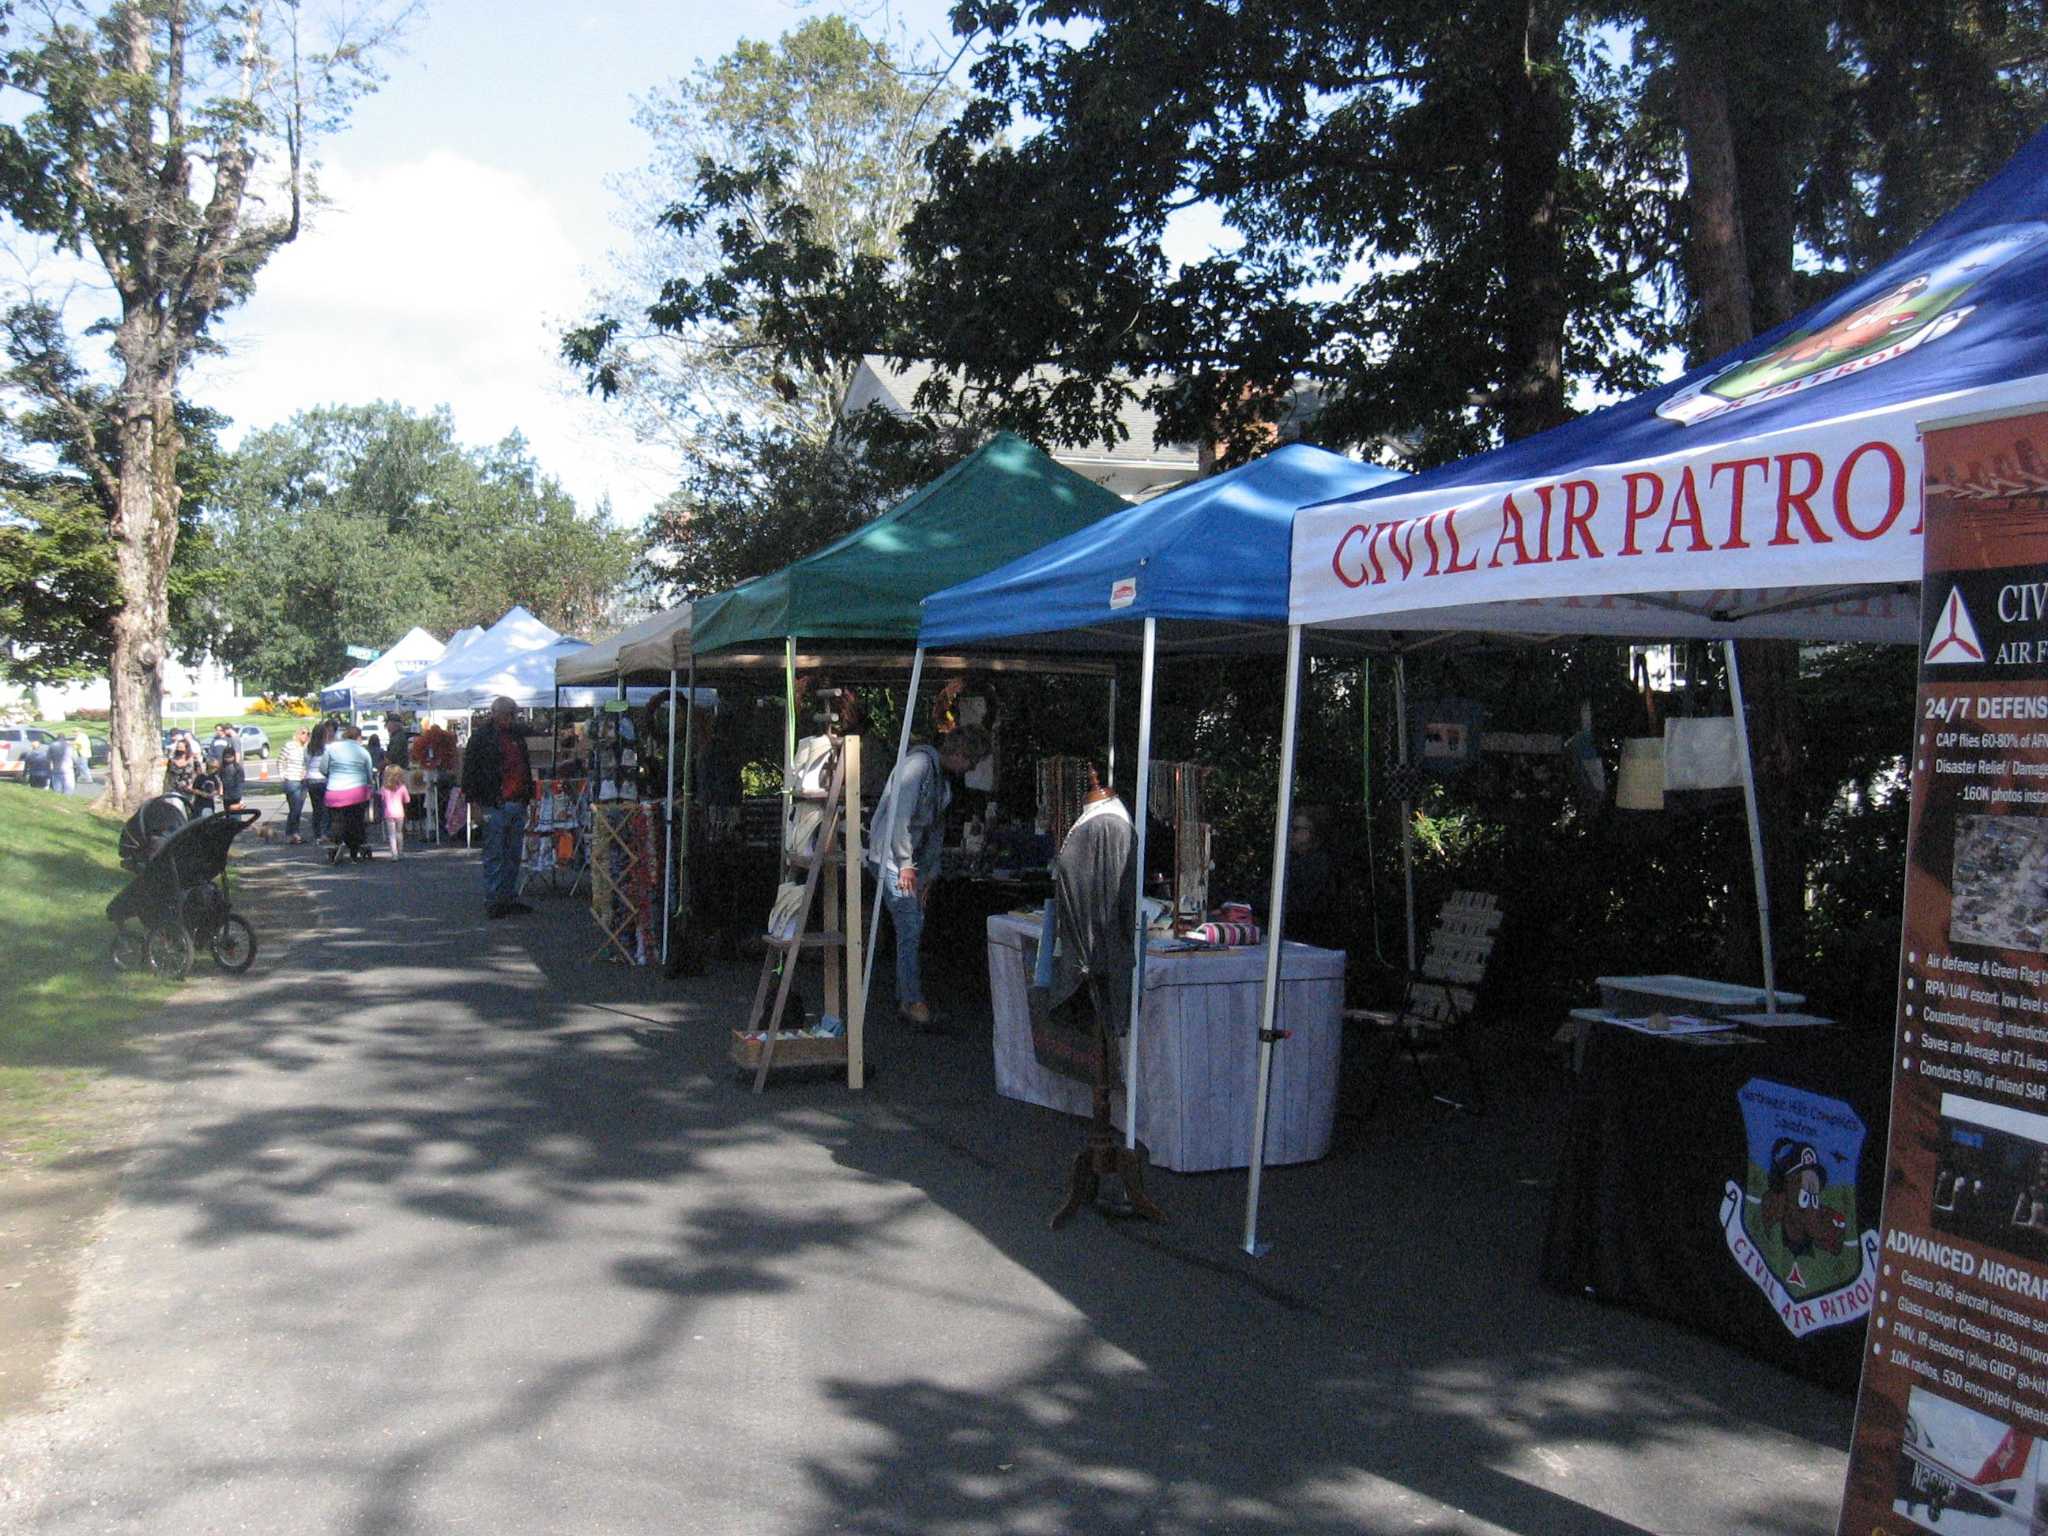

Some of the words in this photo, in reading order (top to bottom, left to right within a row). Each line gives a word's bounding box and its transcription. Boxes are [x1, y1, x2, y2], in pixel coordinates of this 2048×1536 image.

[1331, 507, 1479, 588] CIVIL
[1487, 478, 1605, 568] AIR
[1617, 437, 1925, 557] PATRO
[1994, 642, 2031, 664] AIR
[1925, 697, 1970, 723] 24/7
[1977, 696, 2048, 719] DEFENS
[1936, 732, 1957, 747] CAP
[1959, 733, 1980, 747] flies
[2020, 733, 2031, 748] of
[1935, 759, 1976, 774] Disaster
[1992, 788, 2022, 804] photos
[1927, 953, 1939, 968] Air
[1942, 954, 1979, 975] defense
[1981, 961, 1989, 976] &
[1991, 961, 2018, 979] Green
[2020, 966, 2040, 986] Flag
[2001, 992, 2017, 1008] low
[2020, 994, 2041, 1013] level
[1983, 1017, 2004, 1037] drug
[1921, 1033, 1949, 1051] Saves
[1951, 1043, 1962, 1054] an
[1964, 1042, 1999, 1064] Average
[2001, 1050, 2012, 1064] of
[2013, 1051, 2025, 1068] 71
[1920, 1060, 1962, 1082] Conducts
[1963, 1069, 1983, 1087] 90%
[1984, 1074, 1995, 1089] of
[1996, 1076, 2024, 1096] inland
[2025, 1082, 2046, 1101] SAR
[1886, 1229, 1974, 1275] ADVANCED
[1734, 1238, 1776, 1300] CIVIL
[1780, 1302, 1816, 1329] AIR
[1901, 1269, 1933, 1293] Cessna
[1935, 1280, 1953, 1300] 206
[1955, 1289, 1989, 1314] aircraft
[1990, 1300, 2031, 1328] increase
[1897, 1295, 1923, 1317] Glass
[1924, 1308, 1957, 1331] cockpit
[1958, 1318, 1991, 1343] Cessna
[1993, 1331, 2018, 1354] 182s
[1918, 1331, 1928, 1347] IR
[1928, 1338, 1965, 1362] sensors
[1889, 1349, 1910, 1368] 10K
[1942, 1369, 1963, 1389] 530
[1964, 1381, 2011, 1410] encrypted
